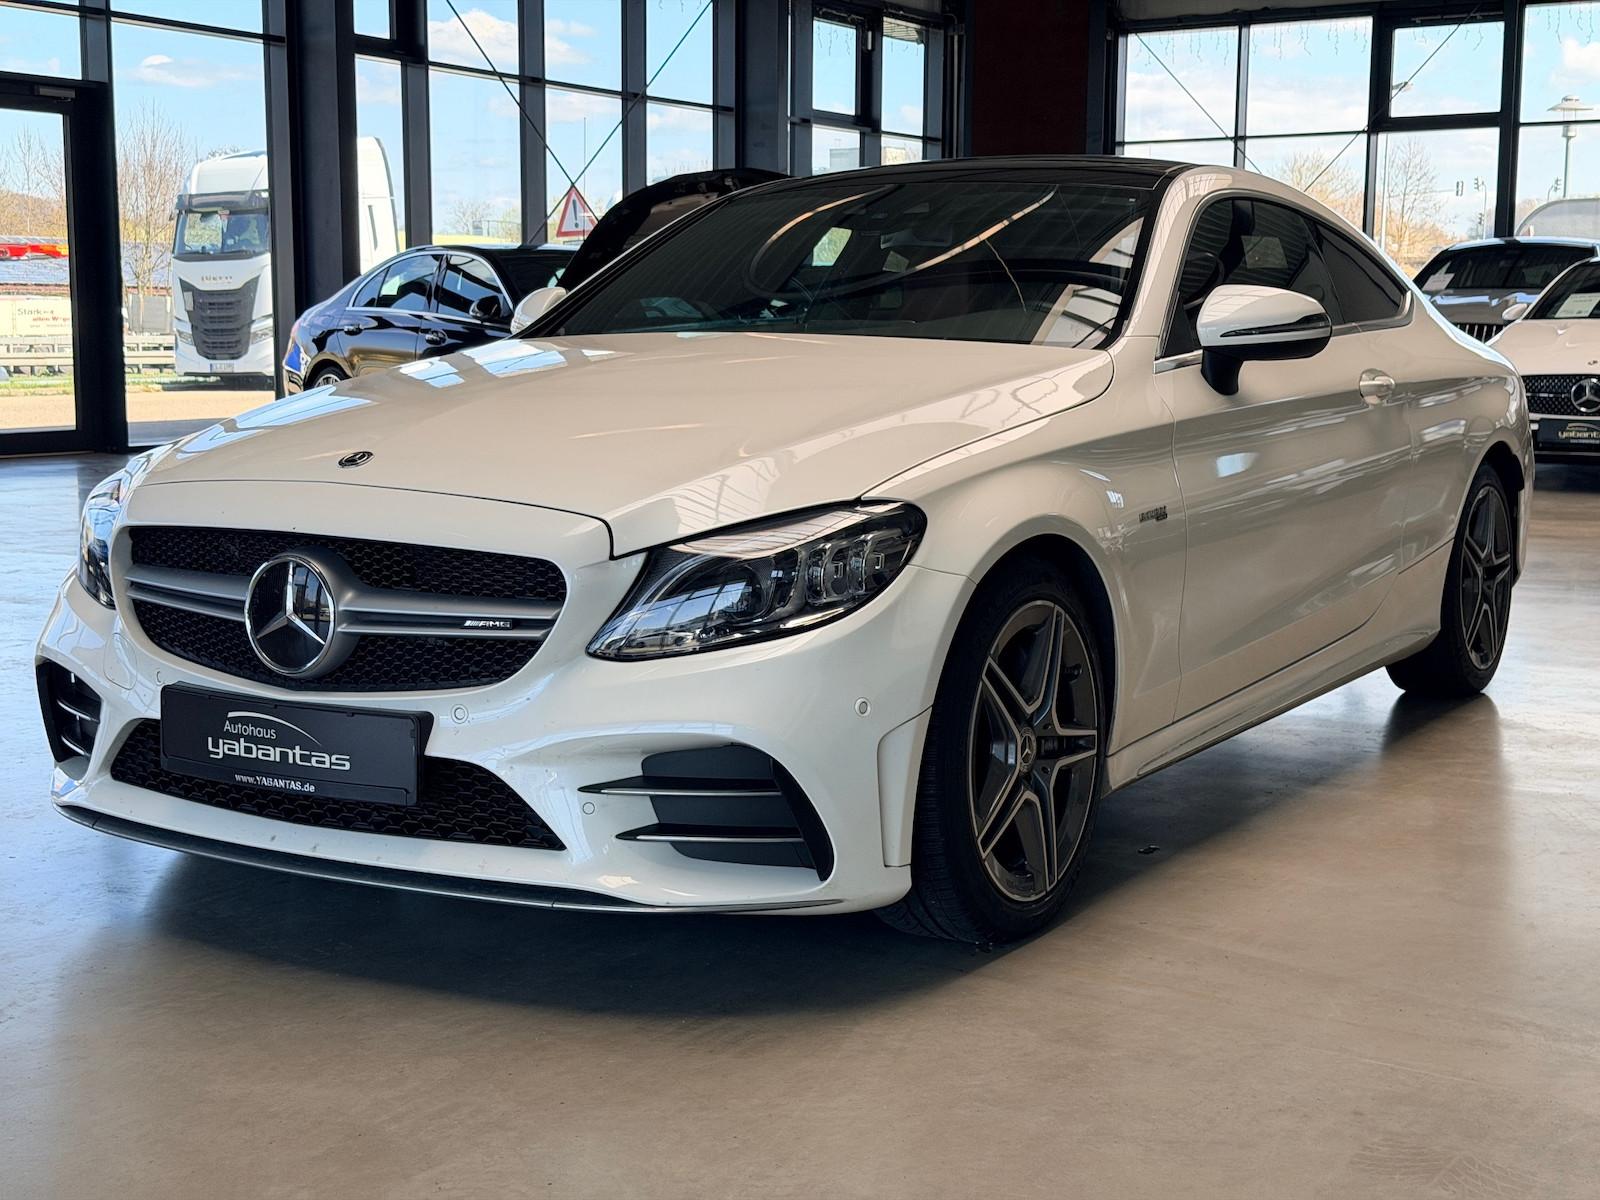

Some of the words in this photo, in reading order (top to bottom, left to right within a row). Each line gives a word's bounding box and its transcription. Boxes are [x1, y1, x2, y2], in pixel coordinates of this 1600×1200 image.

[223, 720, 277, 740] Autohaus
[207, 736, 351, 771] yabantas
[234, 773, 316, 793] www.YABANTAS.de
